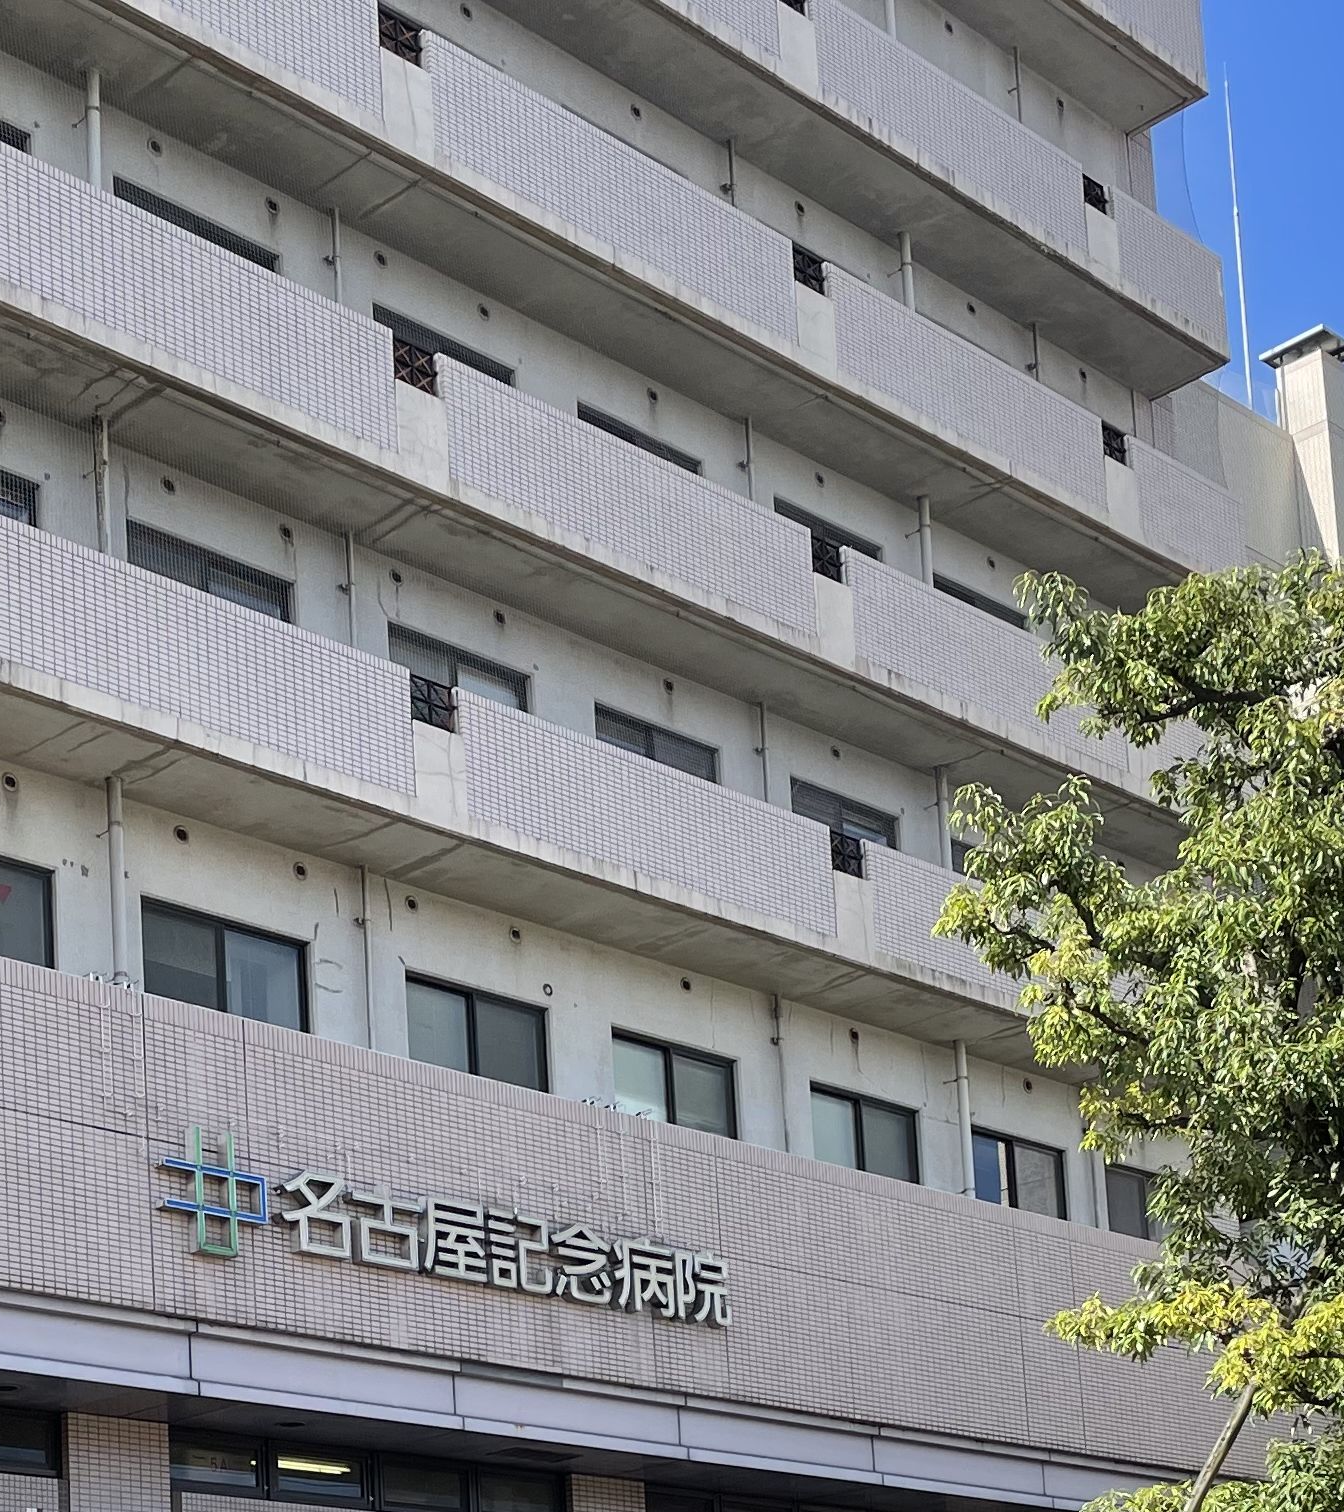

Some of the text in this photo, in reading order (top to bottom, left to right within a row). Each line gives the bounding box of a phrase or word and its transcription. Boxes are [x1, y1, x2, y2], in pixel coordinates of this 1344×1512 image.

[274, 1168, 733, 1327] 名古屋記念病院
